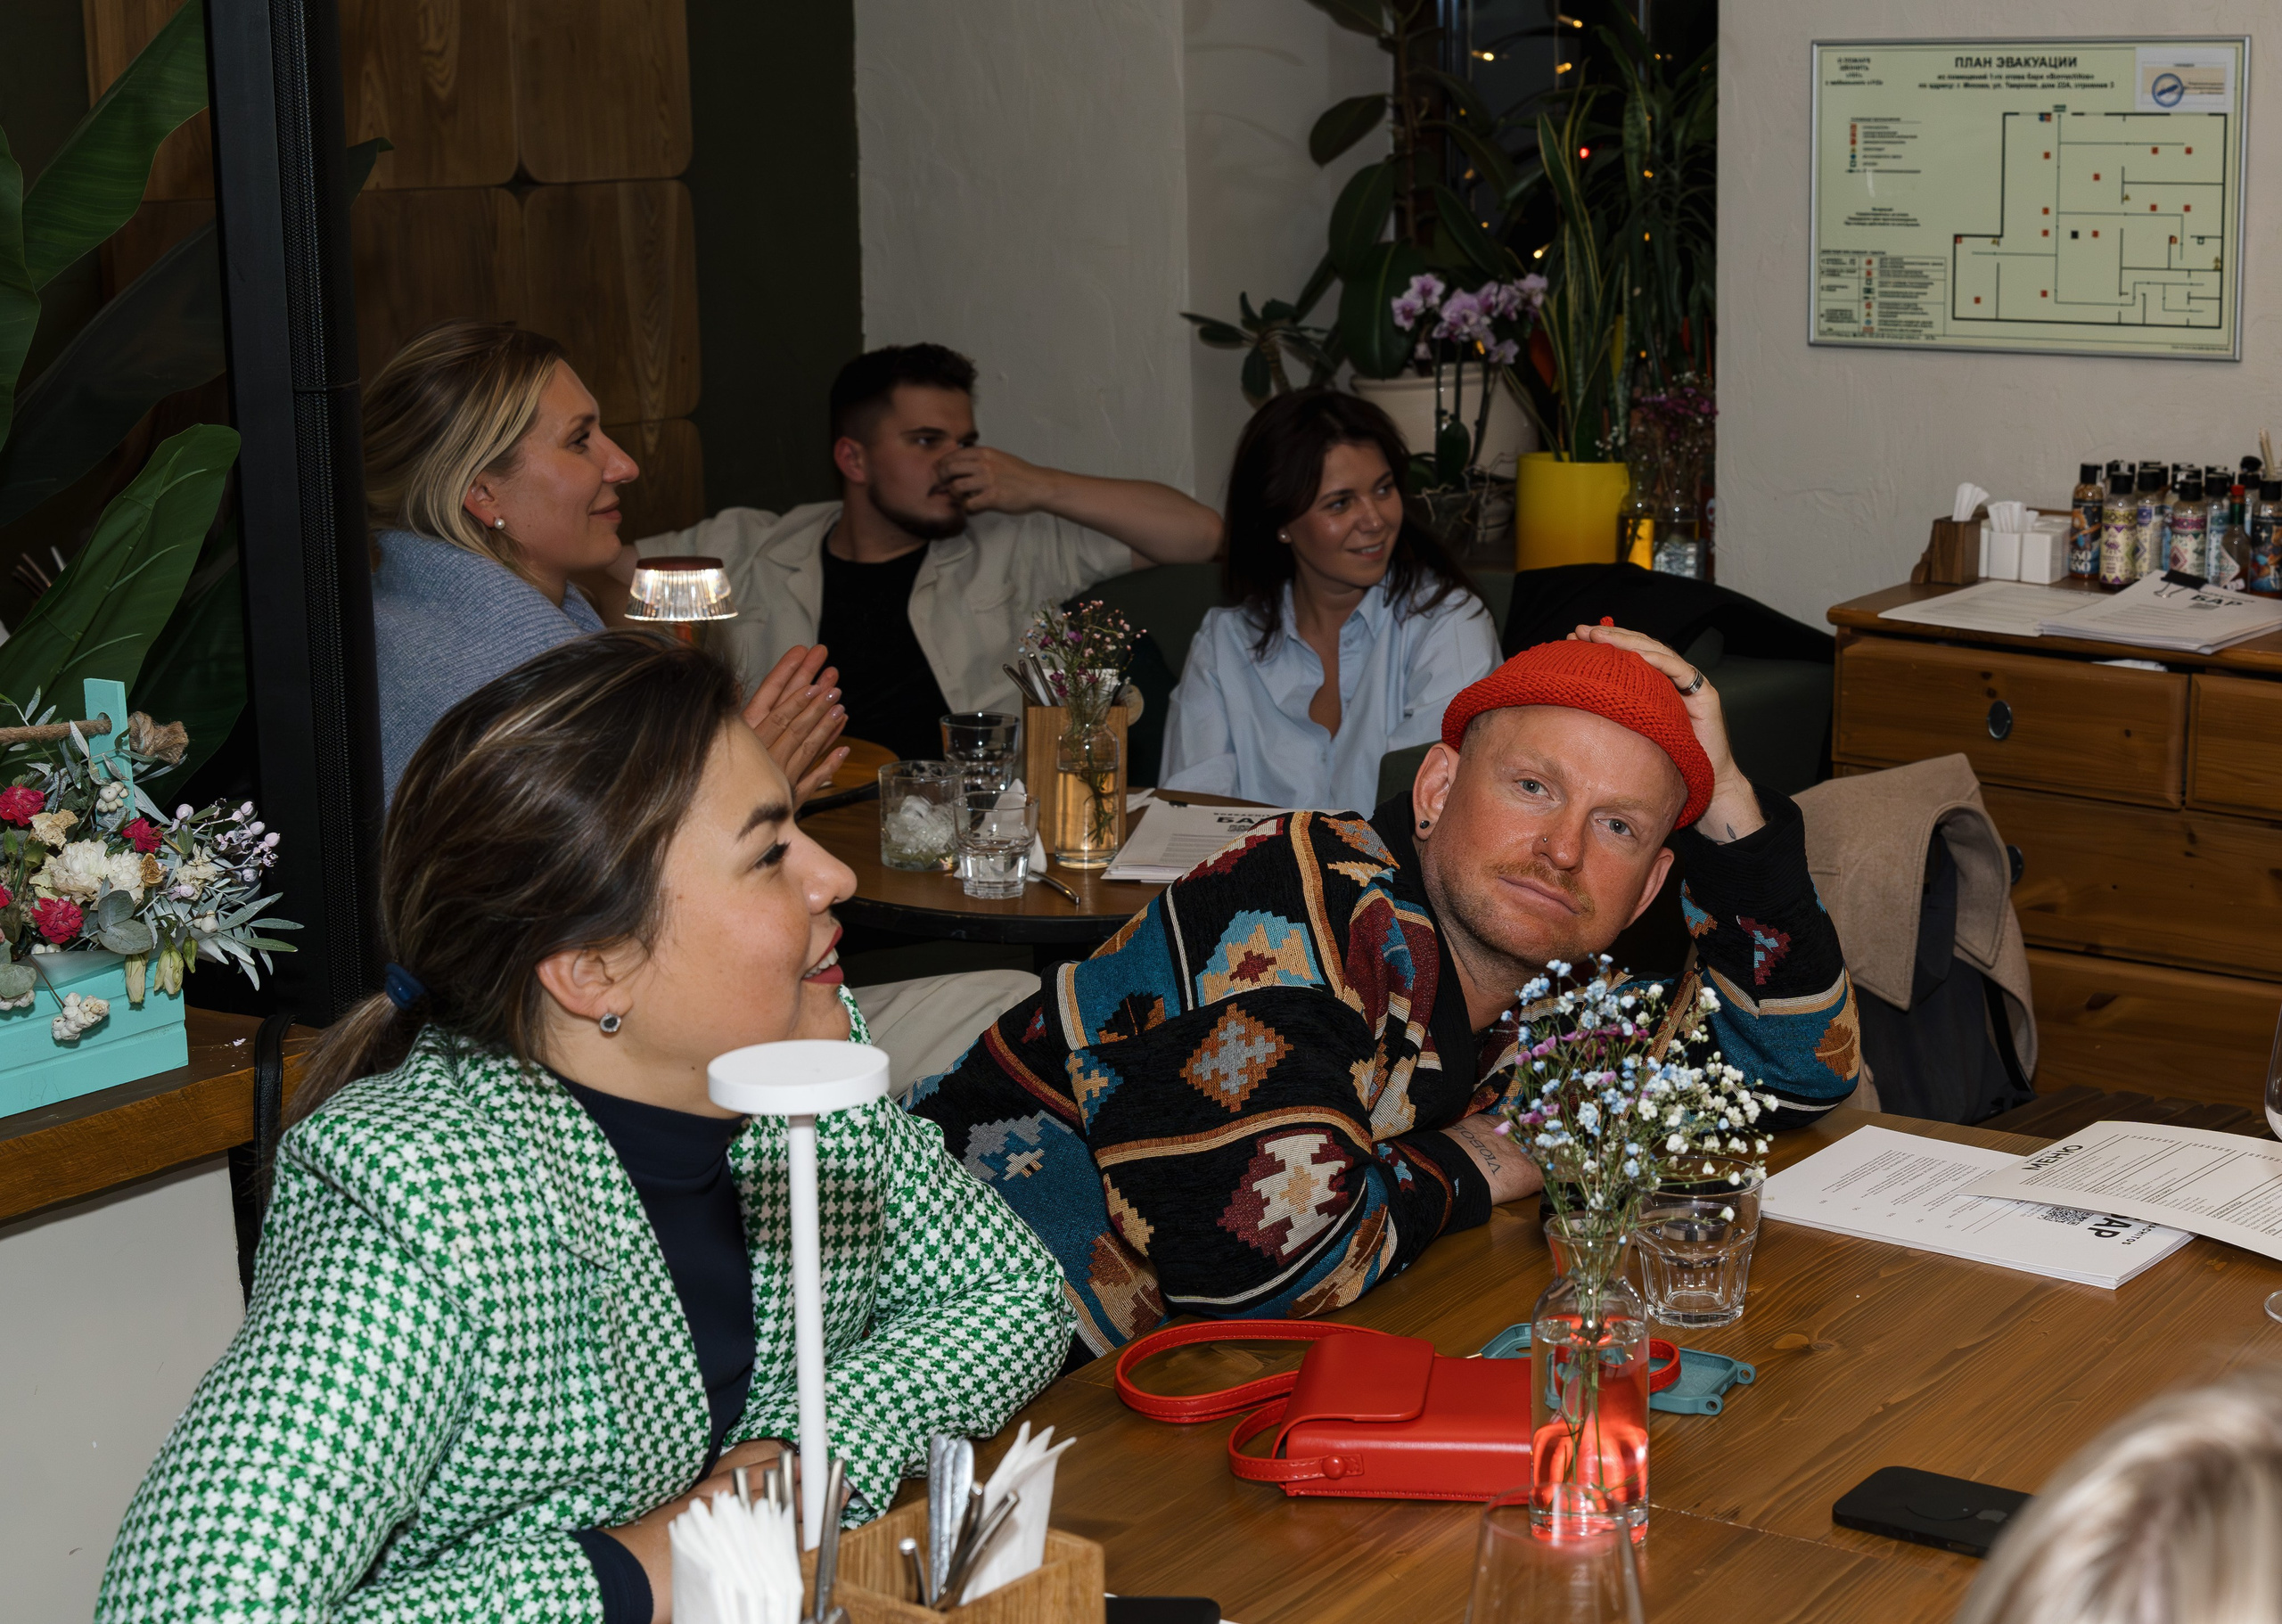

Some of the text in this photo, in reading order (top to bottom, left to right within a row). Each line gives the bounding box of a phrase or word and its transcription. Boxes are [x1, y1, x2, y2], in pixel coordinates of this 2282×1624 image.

[1955, 57, 2078, 69] ПЛАН ЭВАКУАЦИИ
[2190, 595, 2244, 605] БАР
[2021, 1144, 2083, 1171] МЕНЮ
